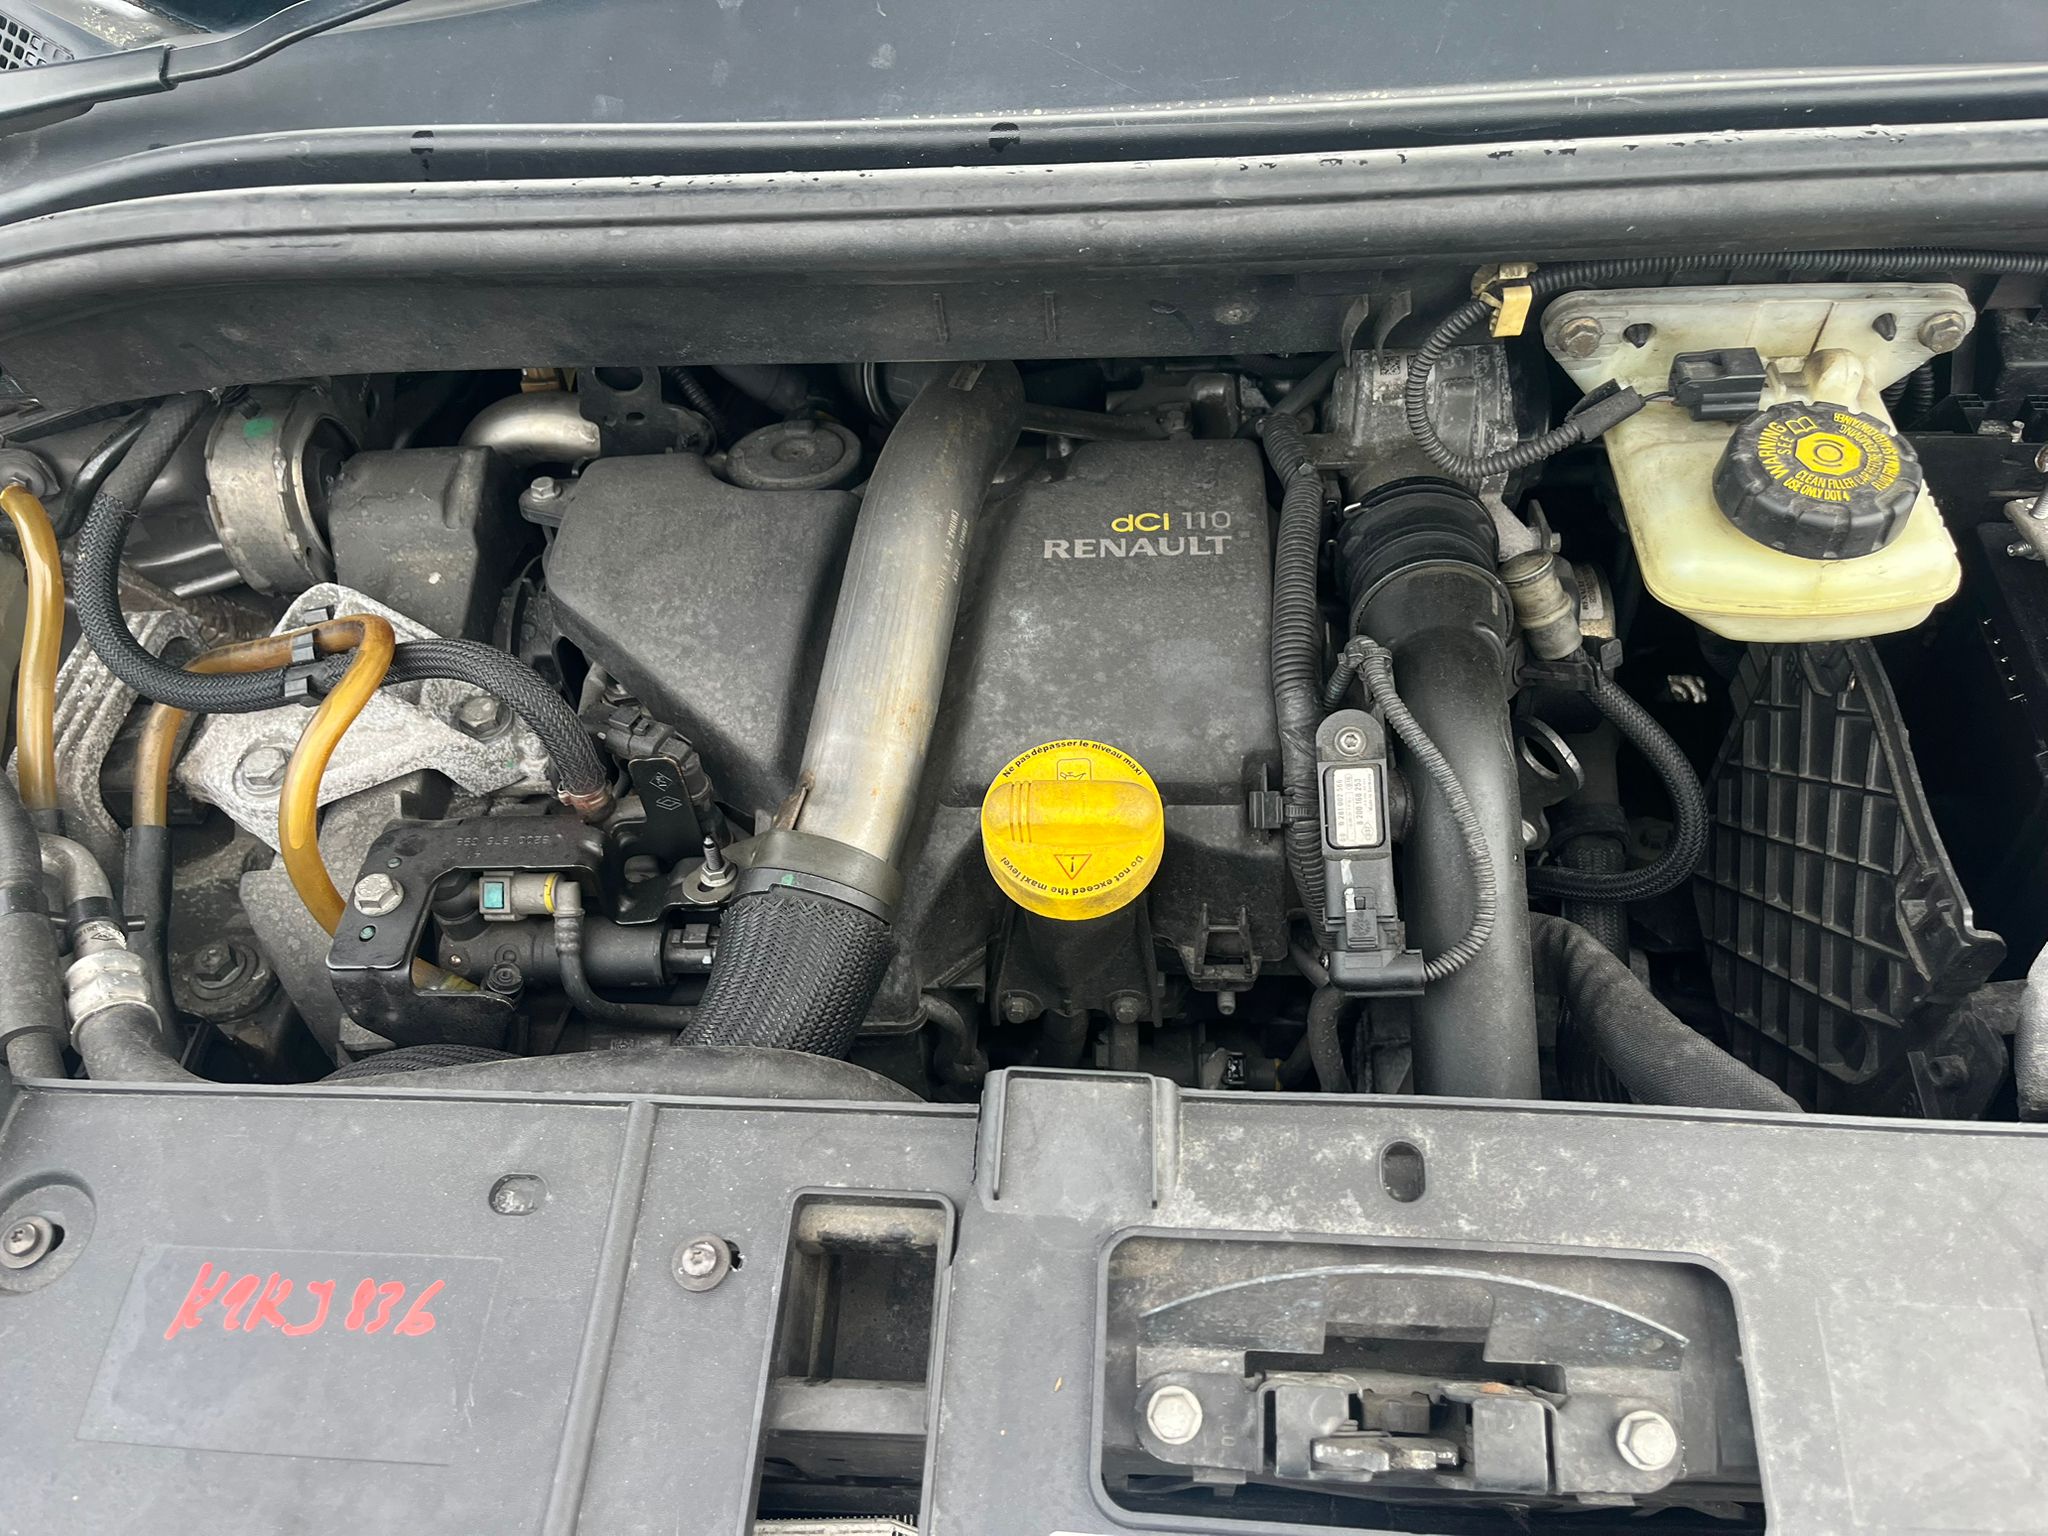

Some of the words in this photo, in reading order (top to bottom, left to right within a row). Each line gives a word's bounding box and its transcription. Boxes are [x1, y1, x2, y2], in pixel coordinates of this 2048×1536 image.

[1833, 412, 1878, 436] CONTAINER
[1778, 435, 1794, 456] SEE
[1838, 424, 1878, 452] REMOVING
[1758, 422, 1789, 480] WARNING
[1795, 470, 1826, 488] CLEAN
[1828, 476, 1858, 489] FILLER
[1783, 478, 1800, 492] USE
[1800, 482, 1823, 498] ONLY
[1824, 489, 1843, 500] DOT
[1842, 490, 1850, 502] 4
[1182, 510, 1232, 530] 110
[1044, 536, 1232, 558] RENAULT
[1002, 766, 1014, 778] Ne
[1015, 754, 1031, 768] pas
[1032, 740, 1077, 756] dépasser
[1079, 740, 1089, 748] le
[1092, 744, 1122, 759] niveau
[1123, 757, 1144, 776] maxi
[1000, 857, 1020, 878] level
[1131, 855, 1144, 868] Do
[1020, 874, 1048, 890] maxi
[1114, 867, 1131, 882] not
[1050, 886, 1069, 896] the
[1072, 880, 1113, 896] exceed
[344, 1278, 446, 1336] 836
